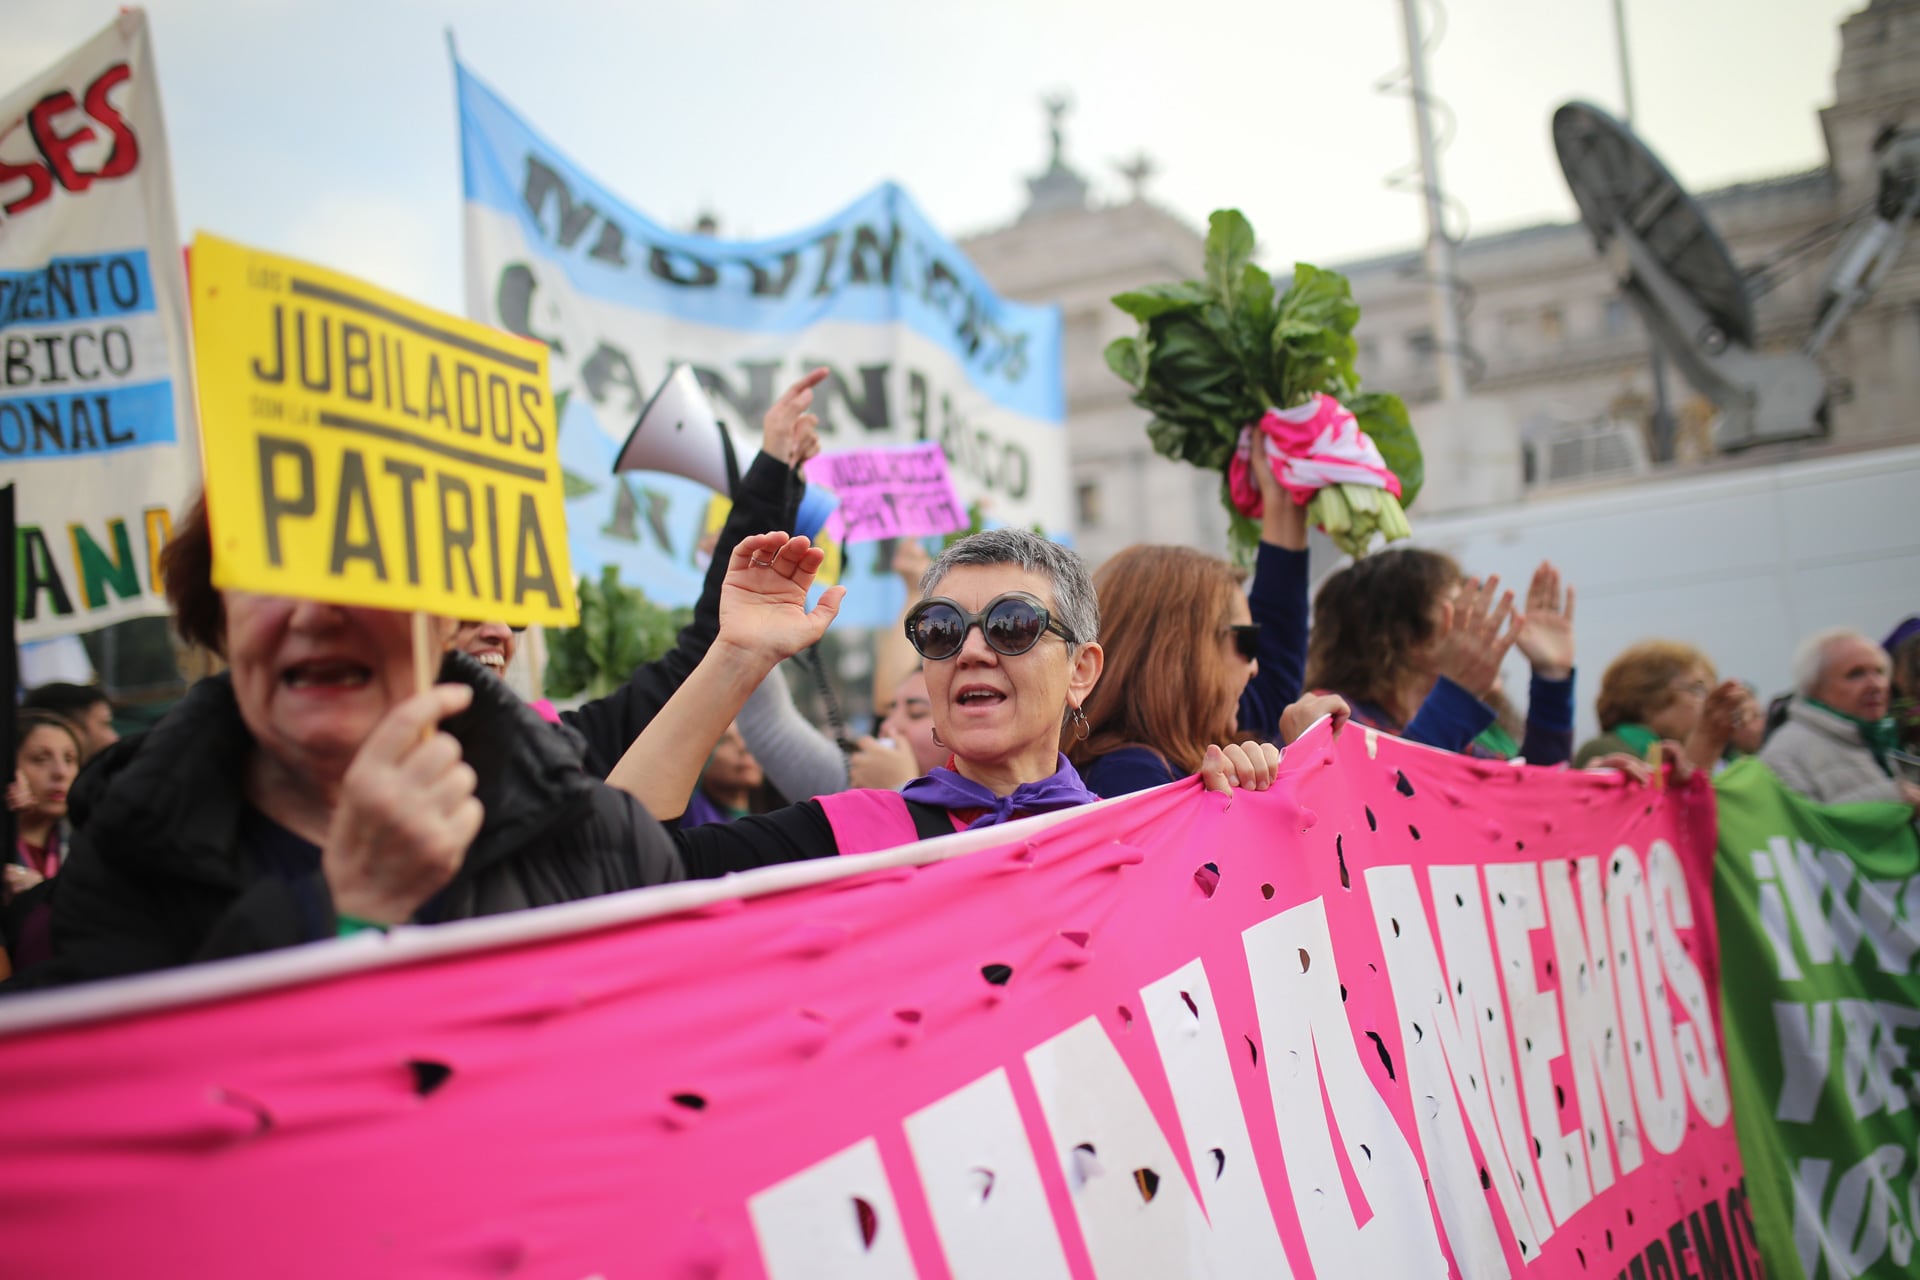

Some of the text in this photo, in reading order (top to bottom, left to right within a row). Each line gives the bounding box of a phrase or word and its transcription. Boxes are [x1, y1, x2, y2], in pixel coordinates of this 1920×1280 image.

[251, 304, 545, 455] JUBILADOS
[257, 434, 562, 610] PATRIA
[1363, 840, 1732, 1280] MENOS
